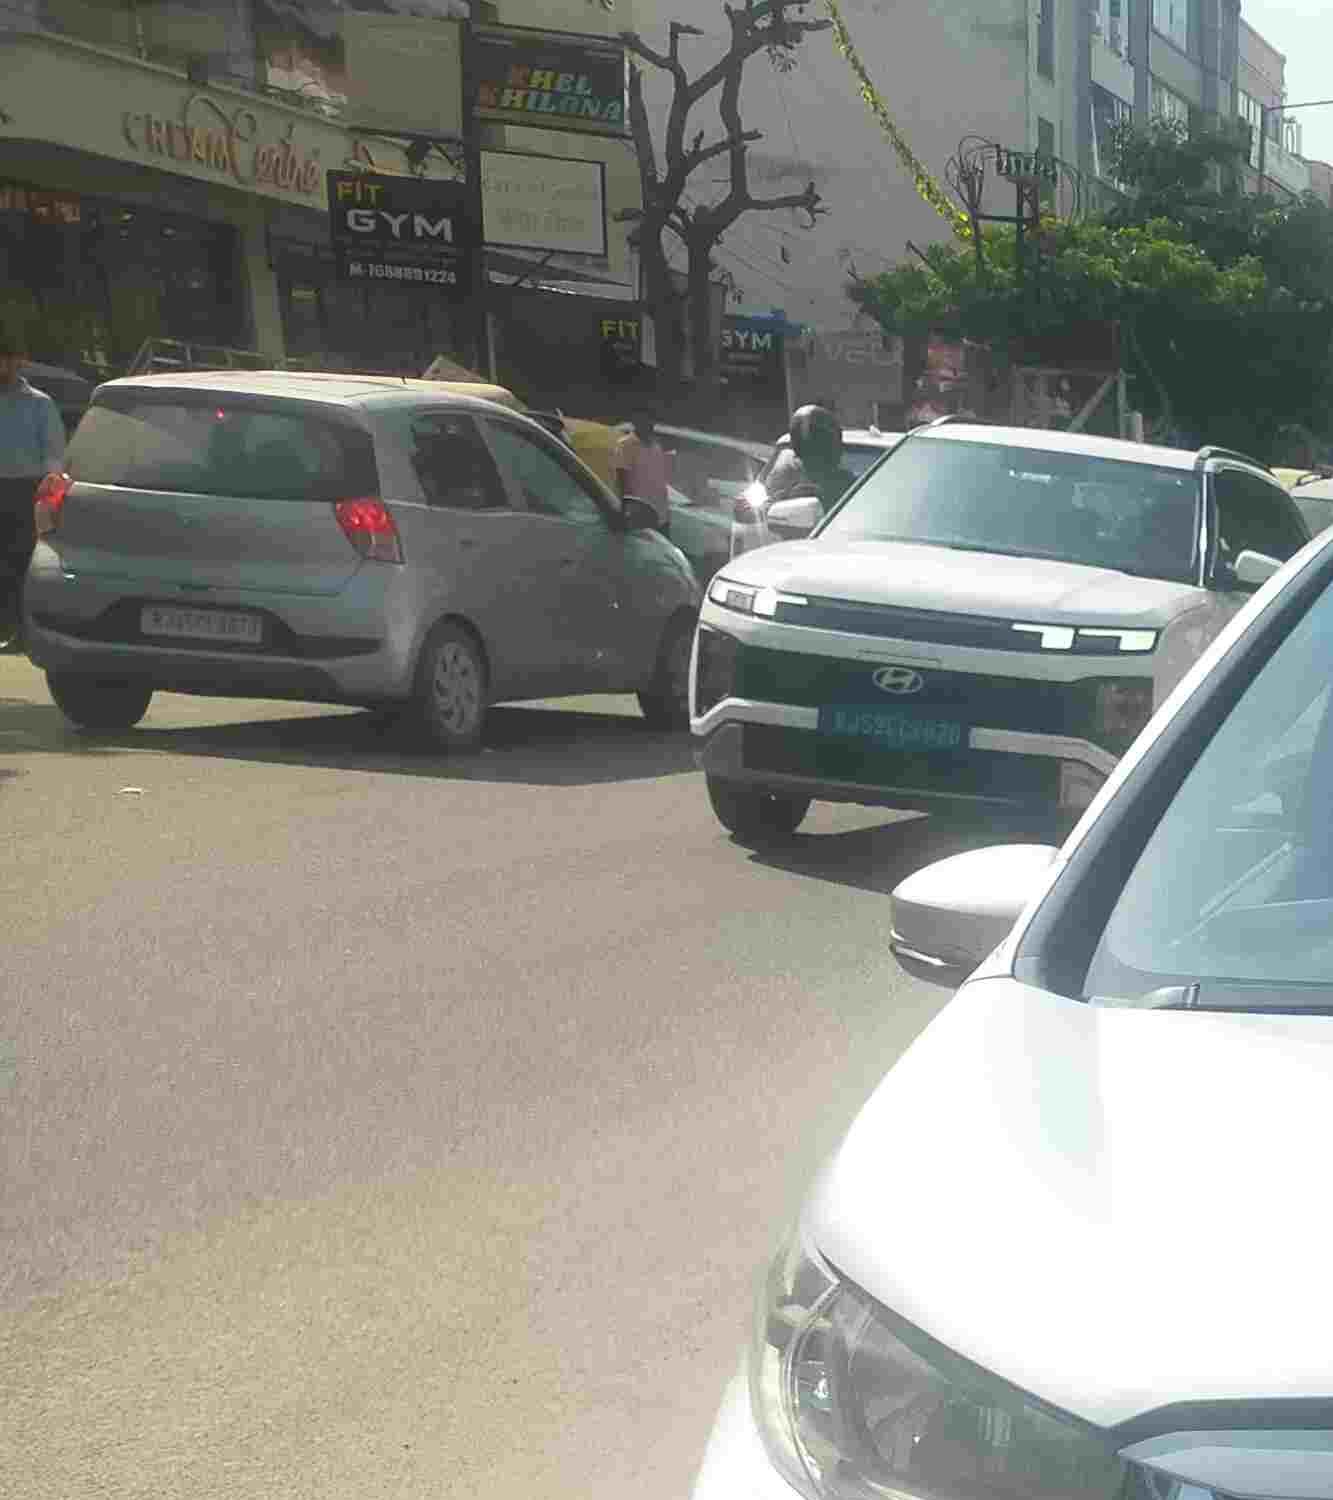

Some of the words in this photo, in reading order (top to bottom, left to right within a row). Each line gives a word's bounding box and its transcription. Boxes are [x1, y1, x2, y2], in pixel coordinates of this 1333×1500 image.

[336, 182, 384, 207] FIT
[346, 209, 453, 243] GYM
[601, 319, 639, 337] FIT
